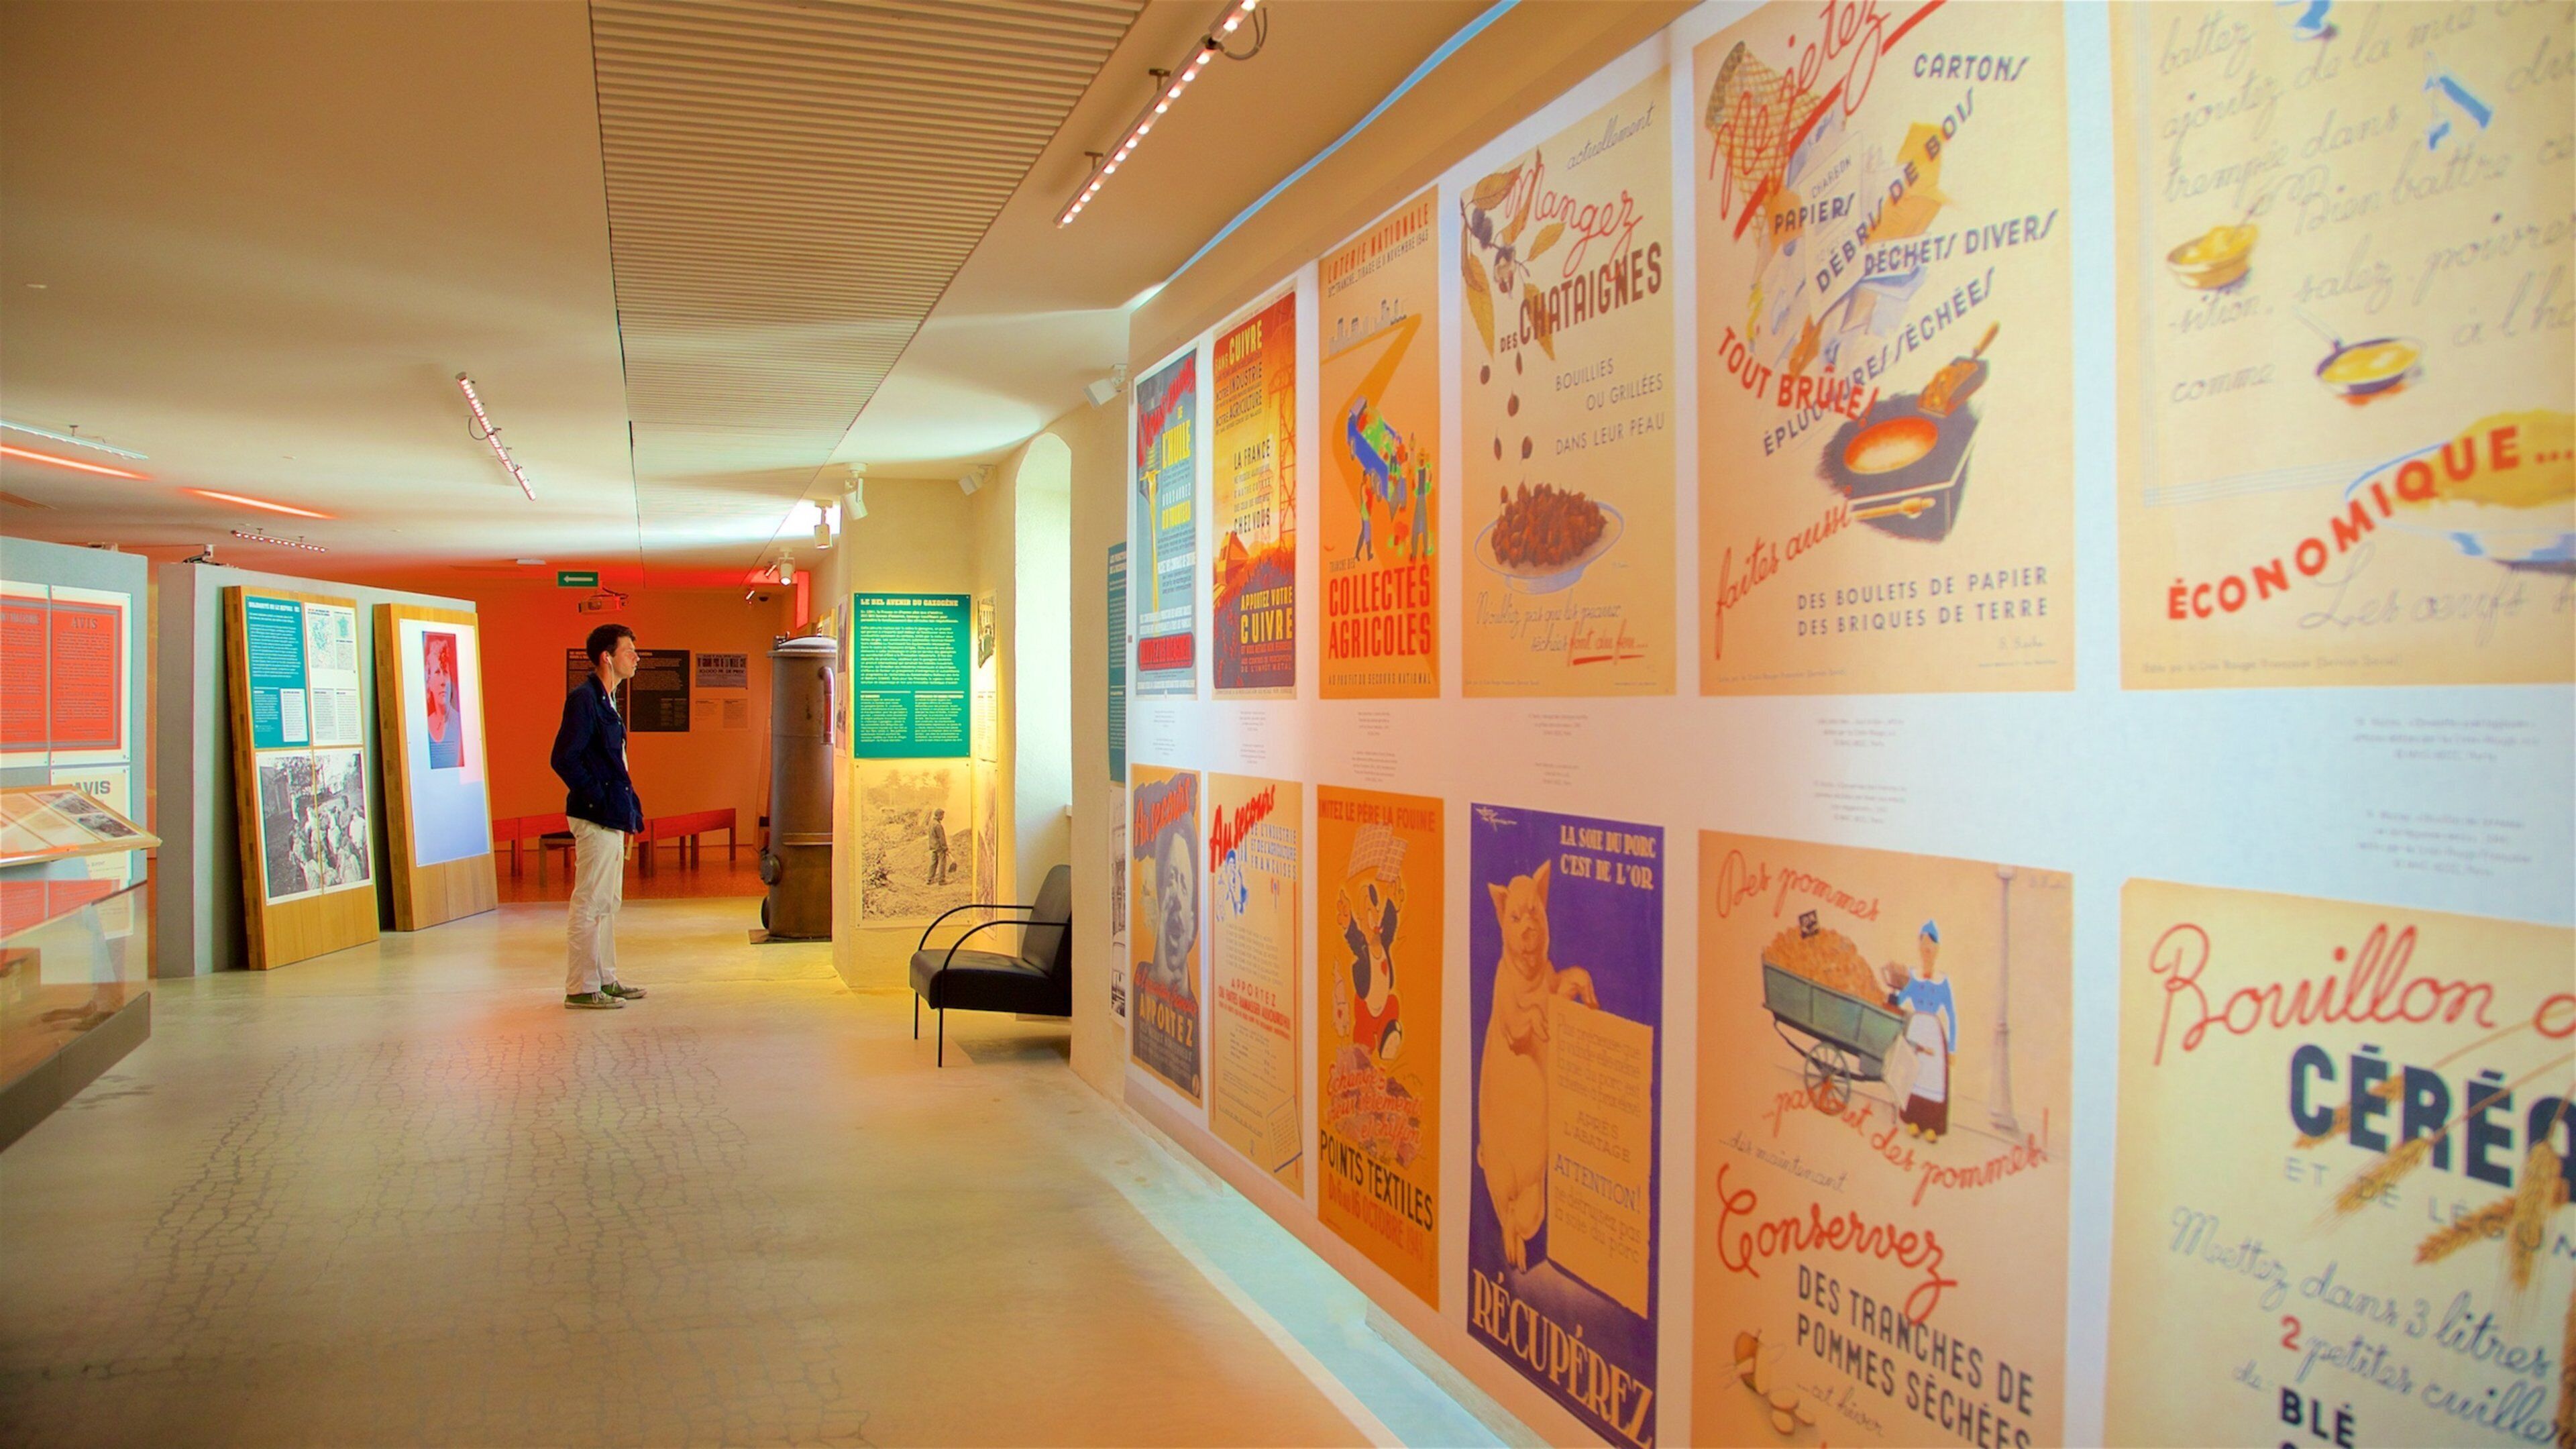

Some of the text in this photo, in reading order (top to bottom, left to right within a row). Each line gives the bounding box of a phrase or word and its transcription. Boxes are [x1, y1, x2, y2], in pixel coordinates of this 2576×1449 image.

[1913, 52, 2030, 83] CARTONS
[1566, 100, 1656, 172] actuellement
[2301, 104, 2400, 160] dans
[1773, 191, 1856, 236] PAPIERS
[1815, 87, 1976, 294] DÉBRIS DE BOIS
[1328, 203, 1429, 284] LOTERIE NATIONALE
[1387, 236, 1415, 263] NOVEMBRE
[1863, 209, 2059, 278] DÉCHETS DIVERS
[2411, 211, 2576, 308] poivre
[1500, 241, 1662, 354] DES CHATAIGNES
[1228, 319, 1263, 366] CUIVRE
[1715, 326, 1772, 400] TOUT
[1762, 266, 1995, 458] ÉPLUCURES SÉCHÉES
[1229, 362, 1263, 394] INDUSTRIE
[1555, 357, 1615, 392] BOUILLIES
[1586, 372, 1664, 411] OU GRILLÉES
[2171, 362, 2277, 405] comme
[1234, 439, 1270, 470] LA FRANCE
[1555, 412, 1666, 455] DANS LEUR PEAU
[1234, 508, 1270, 535] CHEZ VOUS
[1329, 563, 1430, 617] COLLECTES
[1715, 536, 1782, 661] faites
[1798, 566, 2048, 611] DES BOULETS DE PAPIER
[1798, 596, 2048, 637] DES BRIQUES DE TERRE
[1241, 607, 1293, 644] CUIVRE
[1328, 612, 1431, 659] AGRICOLES
[1368, 673, 1396, 685] SECOURS
[1398, 672, 1432, 684] NATIONAL
[1209, 784, 1276, 873] Au secours
[1345, 801, 1355, 822] LE
[1357, 800, 1380, 825] PÈRE
[1383, 805, 1394, 826] LA
[1396, 806, 1436, 834] FOUINE
[1560, 824, 1657, 859] LA SOIE DU PORC
[1560, 853, 1655, 891] C'EST DE L'OR
[1773, 865, 1882, 923] pommes
[1139, 992, 1193, 1048] APPORTEZ
[1231, 978, 1277, 1008] APPORTEZ
[2149, 922, 2497, 1067] Bouillon
[1320, 1128, 1434, 1233] POINTS TEXTILES
[1554, 1152, 1641, 1214] ATTENTION!
[2284, 1156, 2330, 1187] ET
[2359, 1175, 2402, 1209] DE
[1717, 1163, 1958, 1326] Conservez
[2169, 1205, 2553, 1380] Mettez dans 3 litres
[1472, 1267, 1654, 1448] RÉCUPÉREZ
[1799, 1264, 2034, 1418] DES TRANCHES DE
[2280, 1314, 2302, 1352] 2
[2294, 1333, 2416, 1397] petites
[1798, 1312, 2032, 1449] POMMES SÉCHÉES
[2280, 1385, 2357, 1448] BLÉ
